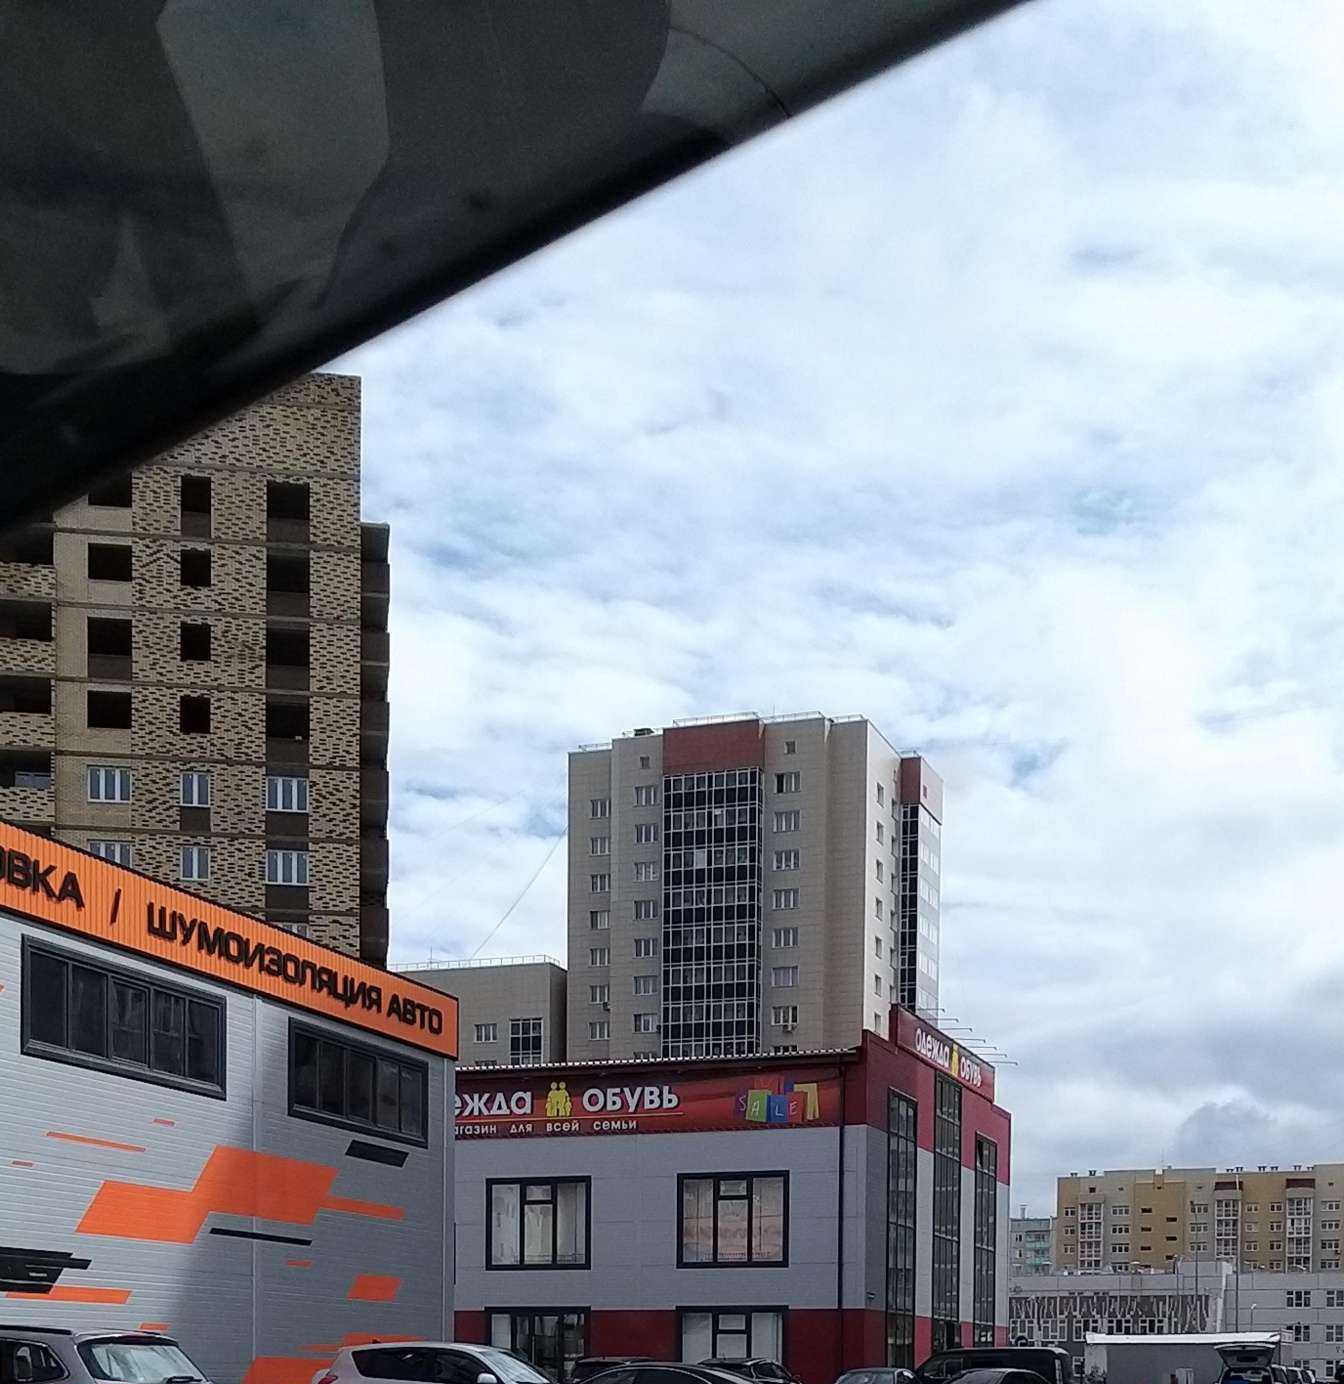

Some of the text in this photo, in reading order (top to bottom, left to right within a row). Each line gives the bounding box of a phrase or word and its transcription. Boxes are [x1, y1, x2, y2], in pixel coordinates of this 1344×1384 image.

[0, 845, 85, 911] ВКА
[147, 901, 383, 1010] ШУМОИЗОЛЯЦИЯ
[386, 993, 443, 1036] АВТО
[582, 1085, 679, 1113] ОБУВЬ
[738, 1094, 799, 1118] SALE
[509, 1123, 533, 1134] для
[546, 1120, 580, 1132] всей
[593, 1119, 637, 1131] семьи
